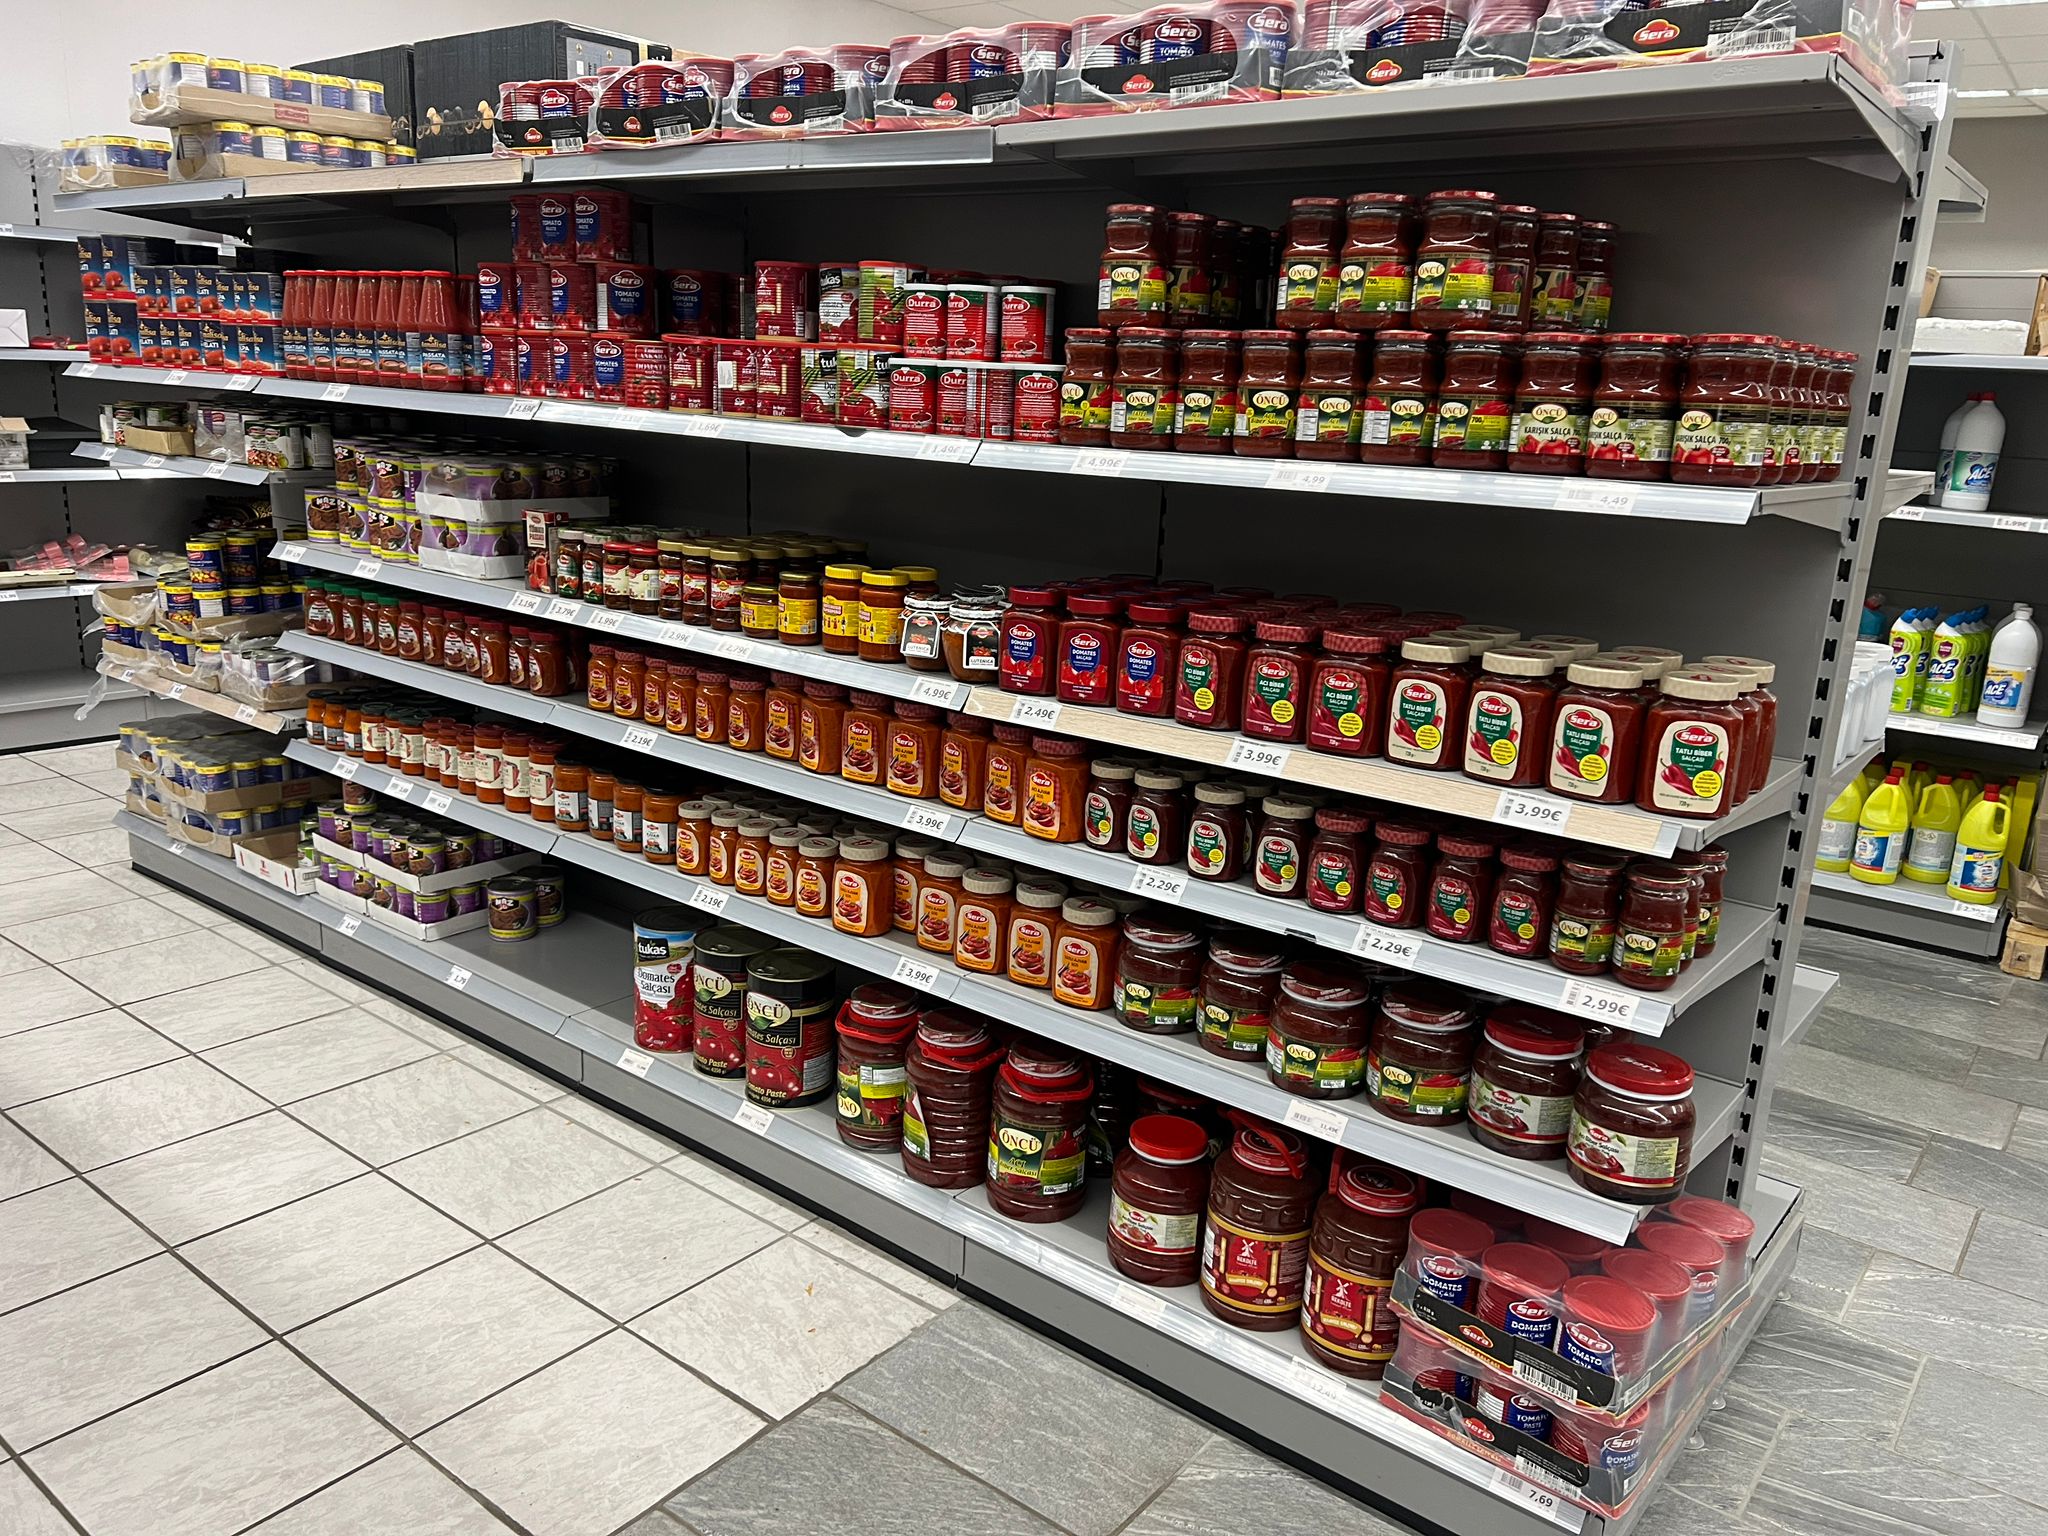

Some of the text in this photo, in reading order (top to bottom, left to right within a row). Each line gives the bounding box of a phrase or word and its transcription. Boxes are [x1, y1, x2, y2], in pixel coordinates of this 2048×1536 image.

[1254, 16, 1287, 30] Sera
[1159, 25, 1197, 37] Sera
[1638, 28, 1674, 42] Sera
[1160, 46, 1194, 56] TOMATO
[1371, 68, 1398, 79] Sera
[1126, 80, 1151, 90] Sera
[934, 98, 955, 107] Sera
[770, 112, 790, 120] Sera
[525, 132, 542, 140] Sera
[1114, 269, 1137, 279] ÖNCÜ
[1290, 267, 1317, 279] ÖNCÜ
[613, 276, 641, 286] Sera
[673, 282, 698, 290] Sera
[908, 298, 936, 308] Durra
[893, 373, 921, 382] Durra
[1022, 379, 1053, 389] Durra
[1127, 394, 1155, 406] ÖNCÜ
[1185, 394, 1211, 406] ÖNCÜ
[1256, 394, 1286, 405] ÖNCÜ
[1322, 401, 1349, 410] ÖNCÜ
[1394, 402, 1422, 415] ÖNCÜ
[1441, 404, 1467, 418] ÖNCÜ
[1536, 408, 1564, 416] ÖNCÜ
[1524, 426, 1570, 437] KARIŞIK SALÇA
[1603, 433, 1622, 442] SALÇA
[1695, 436, 1716, 445] SALÇA
[1969, 466, 1993, 480] ACE
[1012, 629, 1032, 637] Sera
[1074, 638, 1096, 646] Sera
[1132, 647, 1153, 655] Sera
[1187, 653, 1207, 664] Sera
[1261, 666, 1287, 677] Sera
[1929, 663, 1956, 674] ACE
[1326, 678, 1355, 689] Sera
[923, 687, 951, 700] 4,99€
[1406, 688, 1432, 699] Sera
[1985, 685, 2007, 695] ACE
[1403, 702, 1415, 710] TATLI
[1482, 702, 1507, 712] Sera
[1024, 706, 1055, 719] 2,49€
[1570, 715, 1598, 726] Sera
[851, 724, 869, 736] Sera
[1483, 723, 1500, 731] SALÇASI
[631, 735, 652, 746] 2,19€
[896, 736, 914, 747] Sera
[1571, 738, 1590, 746] SALÇASI
[1680, 732, 1713, 742] Sera
[944, 745, 960, 756] Sera
[1244, 749, 1282, 766] 3,99€
[992, 760, 1008, 771] Sera
[1032, 774, 1051, 787] Sera
[1090, 799, 1104, 809] Sera
[1134, 811, 1151, 821] Sera
[1515, 803, 1562, 821] 3,99€
[916, 815, 943, 830] 3,99€
[1196, 826, 1216, 837] Sera
[1266, 842, 1289, 852] Sera
[1322, 859, 1342, 867] Sera
[1374, 870, 1394, 878] Sera
[842, 876, 859, 888] Sera
[1146, 878, 1180, 893] 2,29€
[1440, 884, 1461, 893] Sera
[701, 894, 723, 908] 2,19€
[926, 894, 945, 905] Sera
[1504, 898, 1526, 907] Sera
[966, 911, 987, 923] Sera
[1019, 925, 1040, 937] Sera
[1561, 923, 1584, 935] ÖNCÜ
[1371, 938, 1412, 957] 2,29€
[1626, 936, 1653, 948] ÖNCÜ
[1065, 944, 1088, 955] Sera
[638, 968, 675, 983] Domates
[905, 968, 933, 984] 3,99€
[640, 981, 671, 994] Salçası
[1127, 983, 1150, 998] ÖNCÜ
[708, 1004, 737, 1017] Salçası
[1582, 995, 1630, 1016] 2,99€
[1206, 1004, 1229, 1021] ÖNCÜ
[765, 1032, 796, 1045] Salçası
[1287, 1044, 1316, 1060] ÖNCÜ
[708, 1058, 728, 1068] Paste
[1384, 1067, 1412, 1085] ÖNCÜ
[766, 1087, 787, 1098] Paste
[1495, 1093, 1513, 1103] Sera
[1002, 1130, 1039, 1151] ÖNCÜ
[1590, 1130, 1609, 1141] Sera
[1427, 1259, 1465, 1275] Sera
[1423, 1276, 1463, 1292] DOMATES
[1511, 1321, 1552, 1331] DOMATES
[1463, 1327, 1489, 1346] Sera
[1570, 1327, 1608, 1351] Sera
[1567, 1342, 1602, 1366] TOMATO
[1465, 1418, 1491, 1439] Sera
[1529, 1489, 1554, 1507] 7,69
